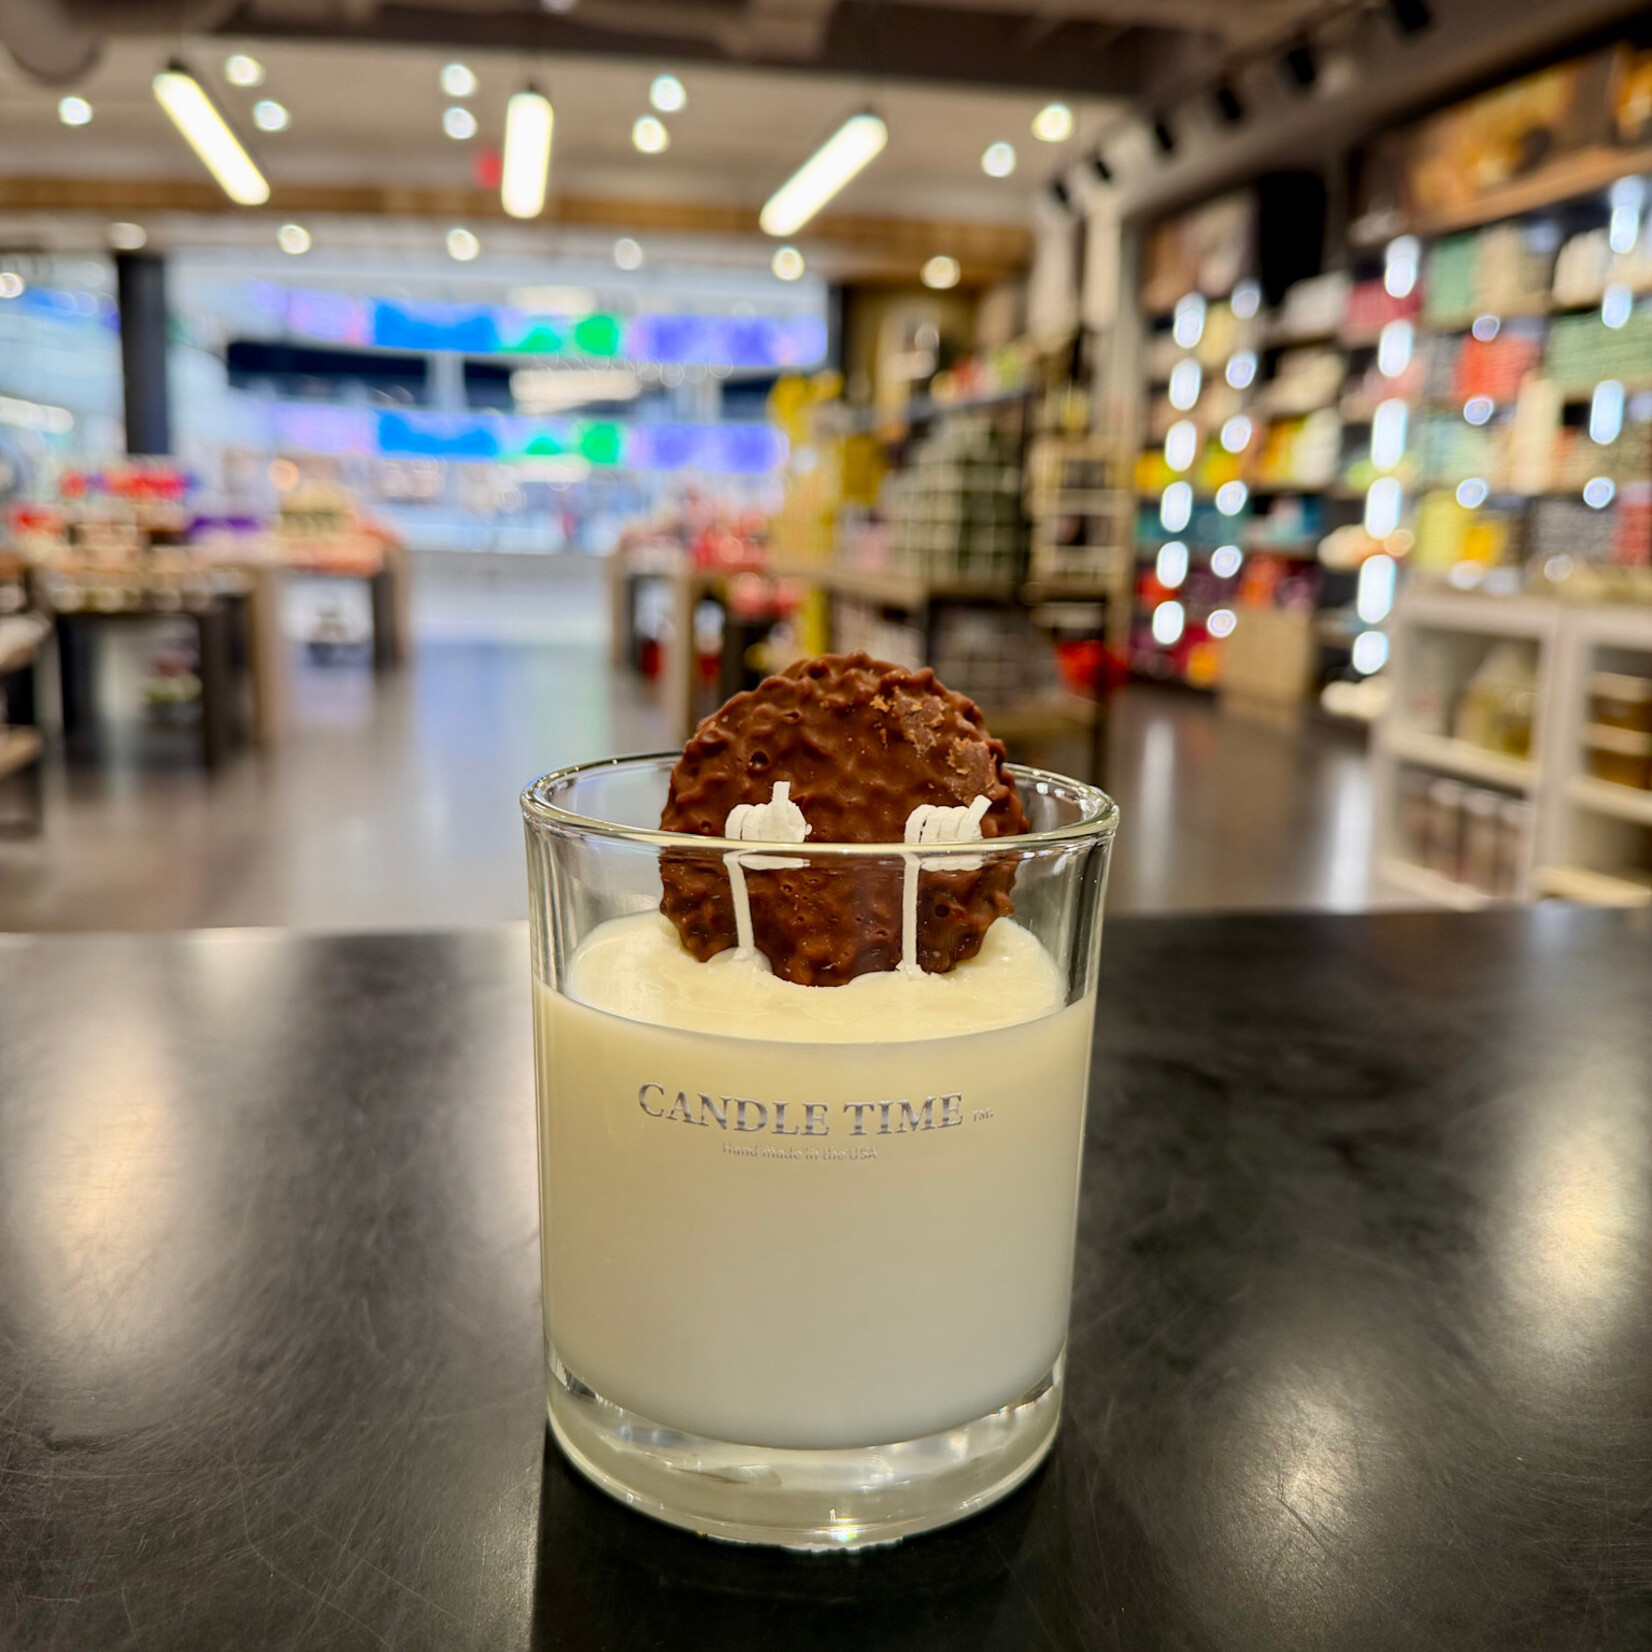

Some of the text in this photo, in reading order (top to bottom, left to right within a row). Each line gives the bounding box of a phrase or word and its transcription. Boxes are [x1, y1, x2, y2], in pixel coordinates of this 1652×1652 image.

[638, 1082, 829, 1136] CANDLE
[843, 1092, 964, 1136] TIME
[722, 1142, 879, 1161] Hand made in the USA
